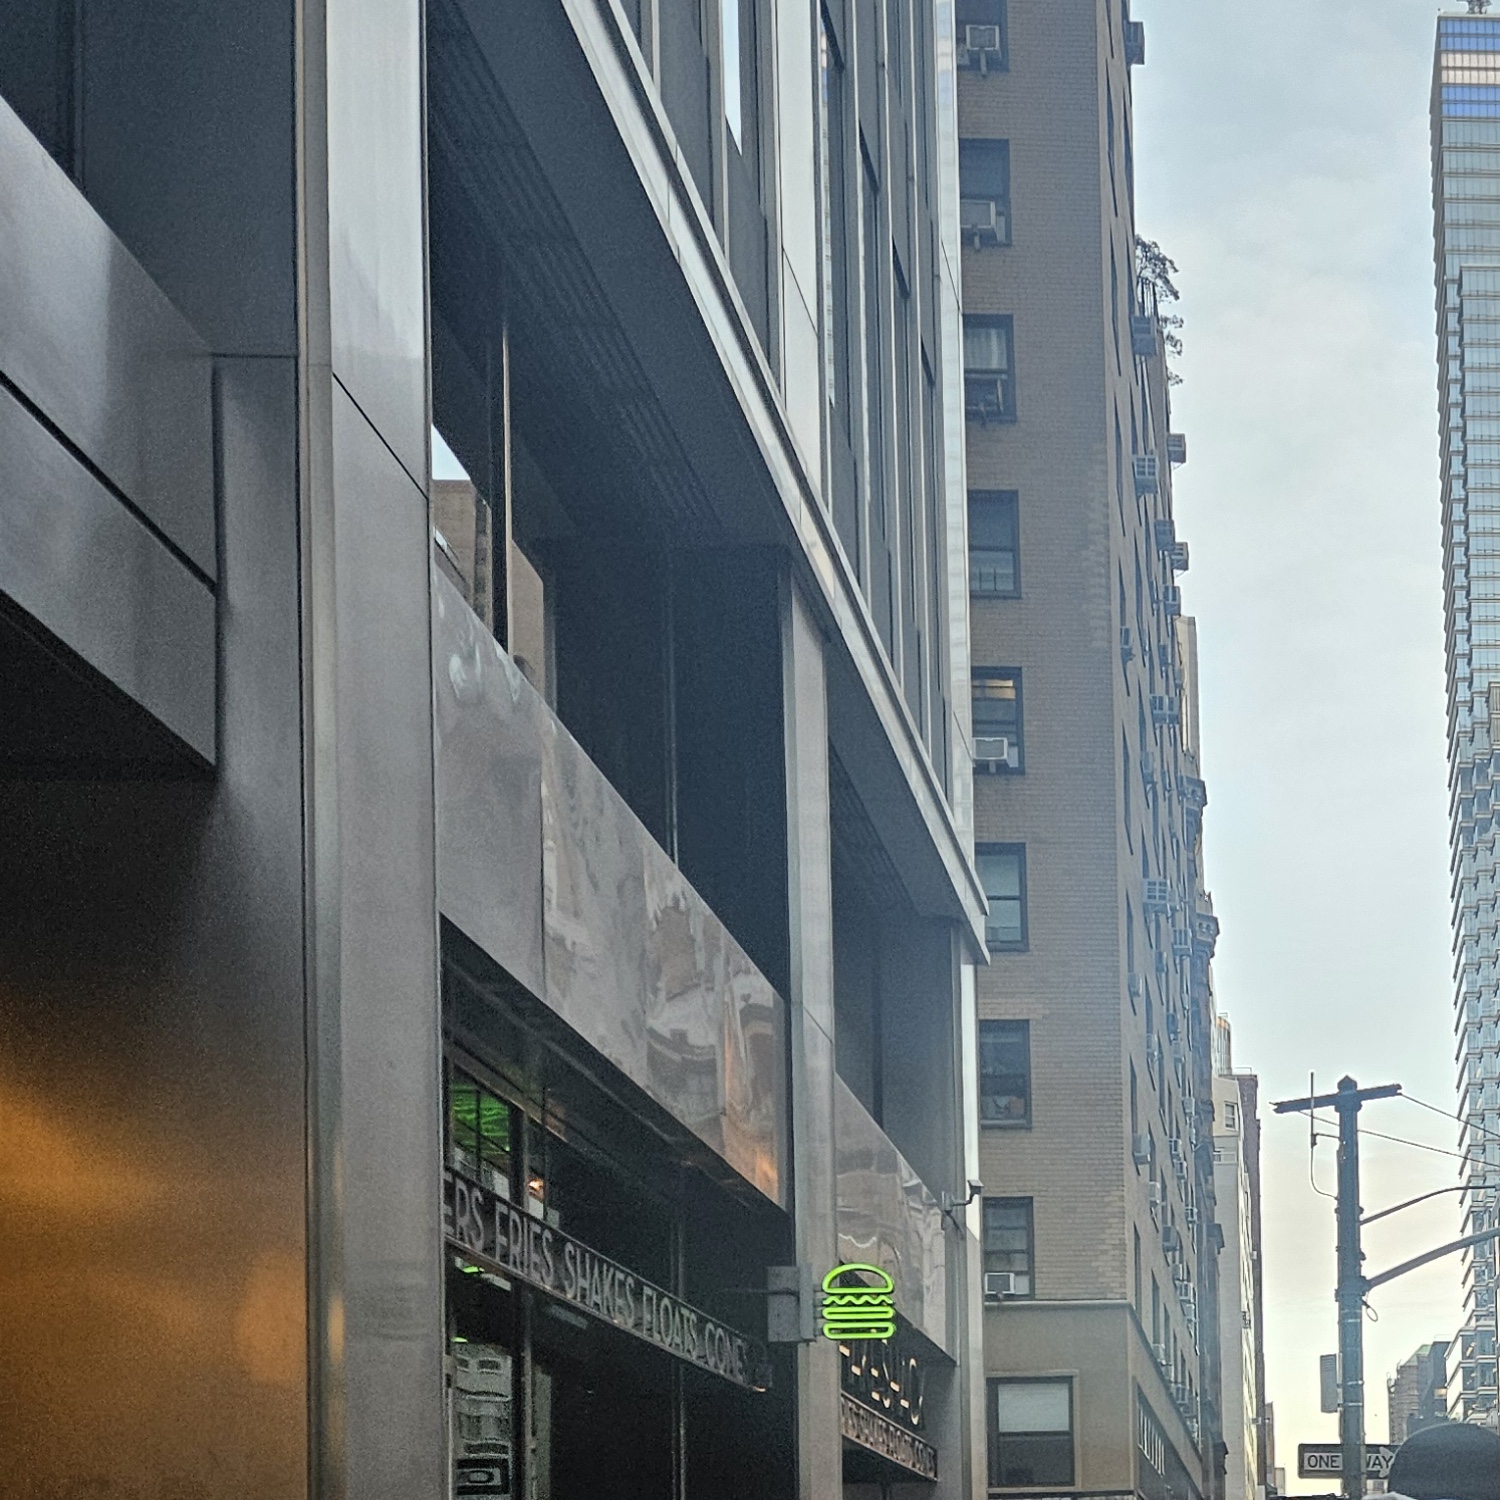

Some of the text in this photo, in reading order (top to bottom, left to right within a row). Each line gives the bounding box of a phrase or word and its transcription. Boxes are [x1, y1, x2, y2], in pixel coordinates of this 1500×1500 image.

[495, 1201, 554, 1287] FRIES
[563, 1242, 635, 1327] SHAKES
[643, 1284, 698, 1362] FLOATS
[1307, 1454, 1394, 1469] ONE AY
